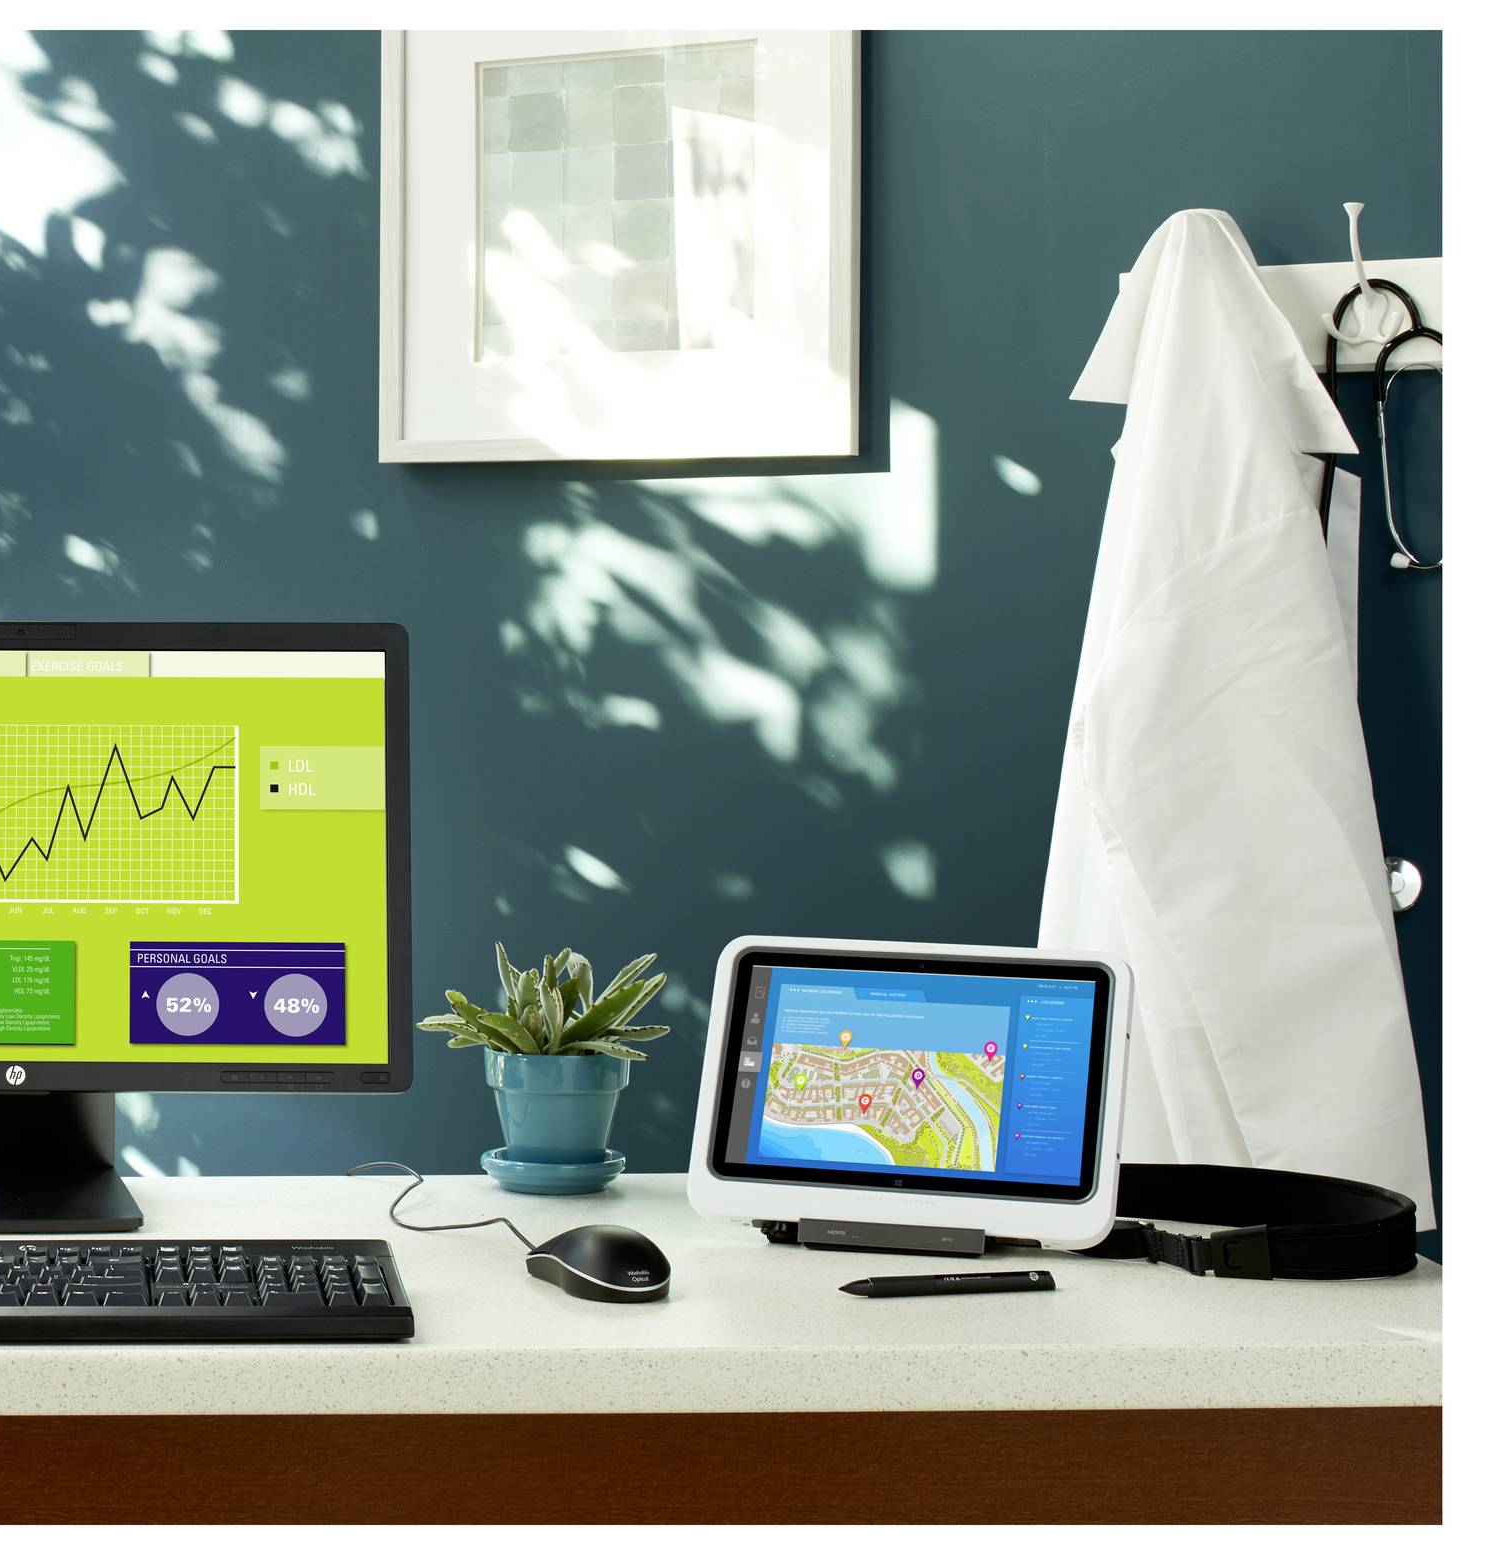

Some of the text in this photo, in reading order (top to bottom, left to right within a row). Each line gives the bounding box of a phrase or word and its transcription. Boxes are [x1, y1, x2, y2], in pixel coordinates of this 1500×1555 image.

[31, 660, 124, 672] EXERCISE GOALS
[288, 758, 313, 772] LDL
[288, 782, 316, 796] HDL
[8, 906, 23, 914] JUN
[42, 906, 54, 914] JUL
[72, 906, 87, 914] AUG
[104, 906, 118, 914] SEP
[136, 906, 149, 914] OCT
[166, 906, 182, 914] NOV
[198, 906, 212, 914] DEC
[138, 954, 227, 964] PERSONAL GOALS
[166, 998, 211, 1012] 52%
[274, 998, 319, 1014] 48%
[7, 1065, 25, 1086] hp
